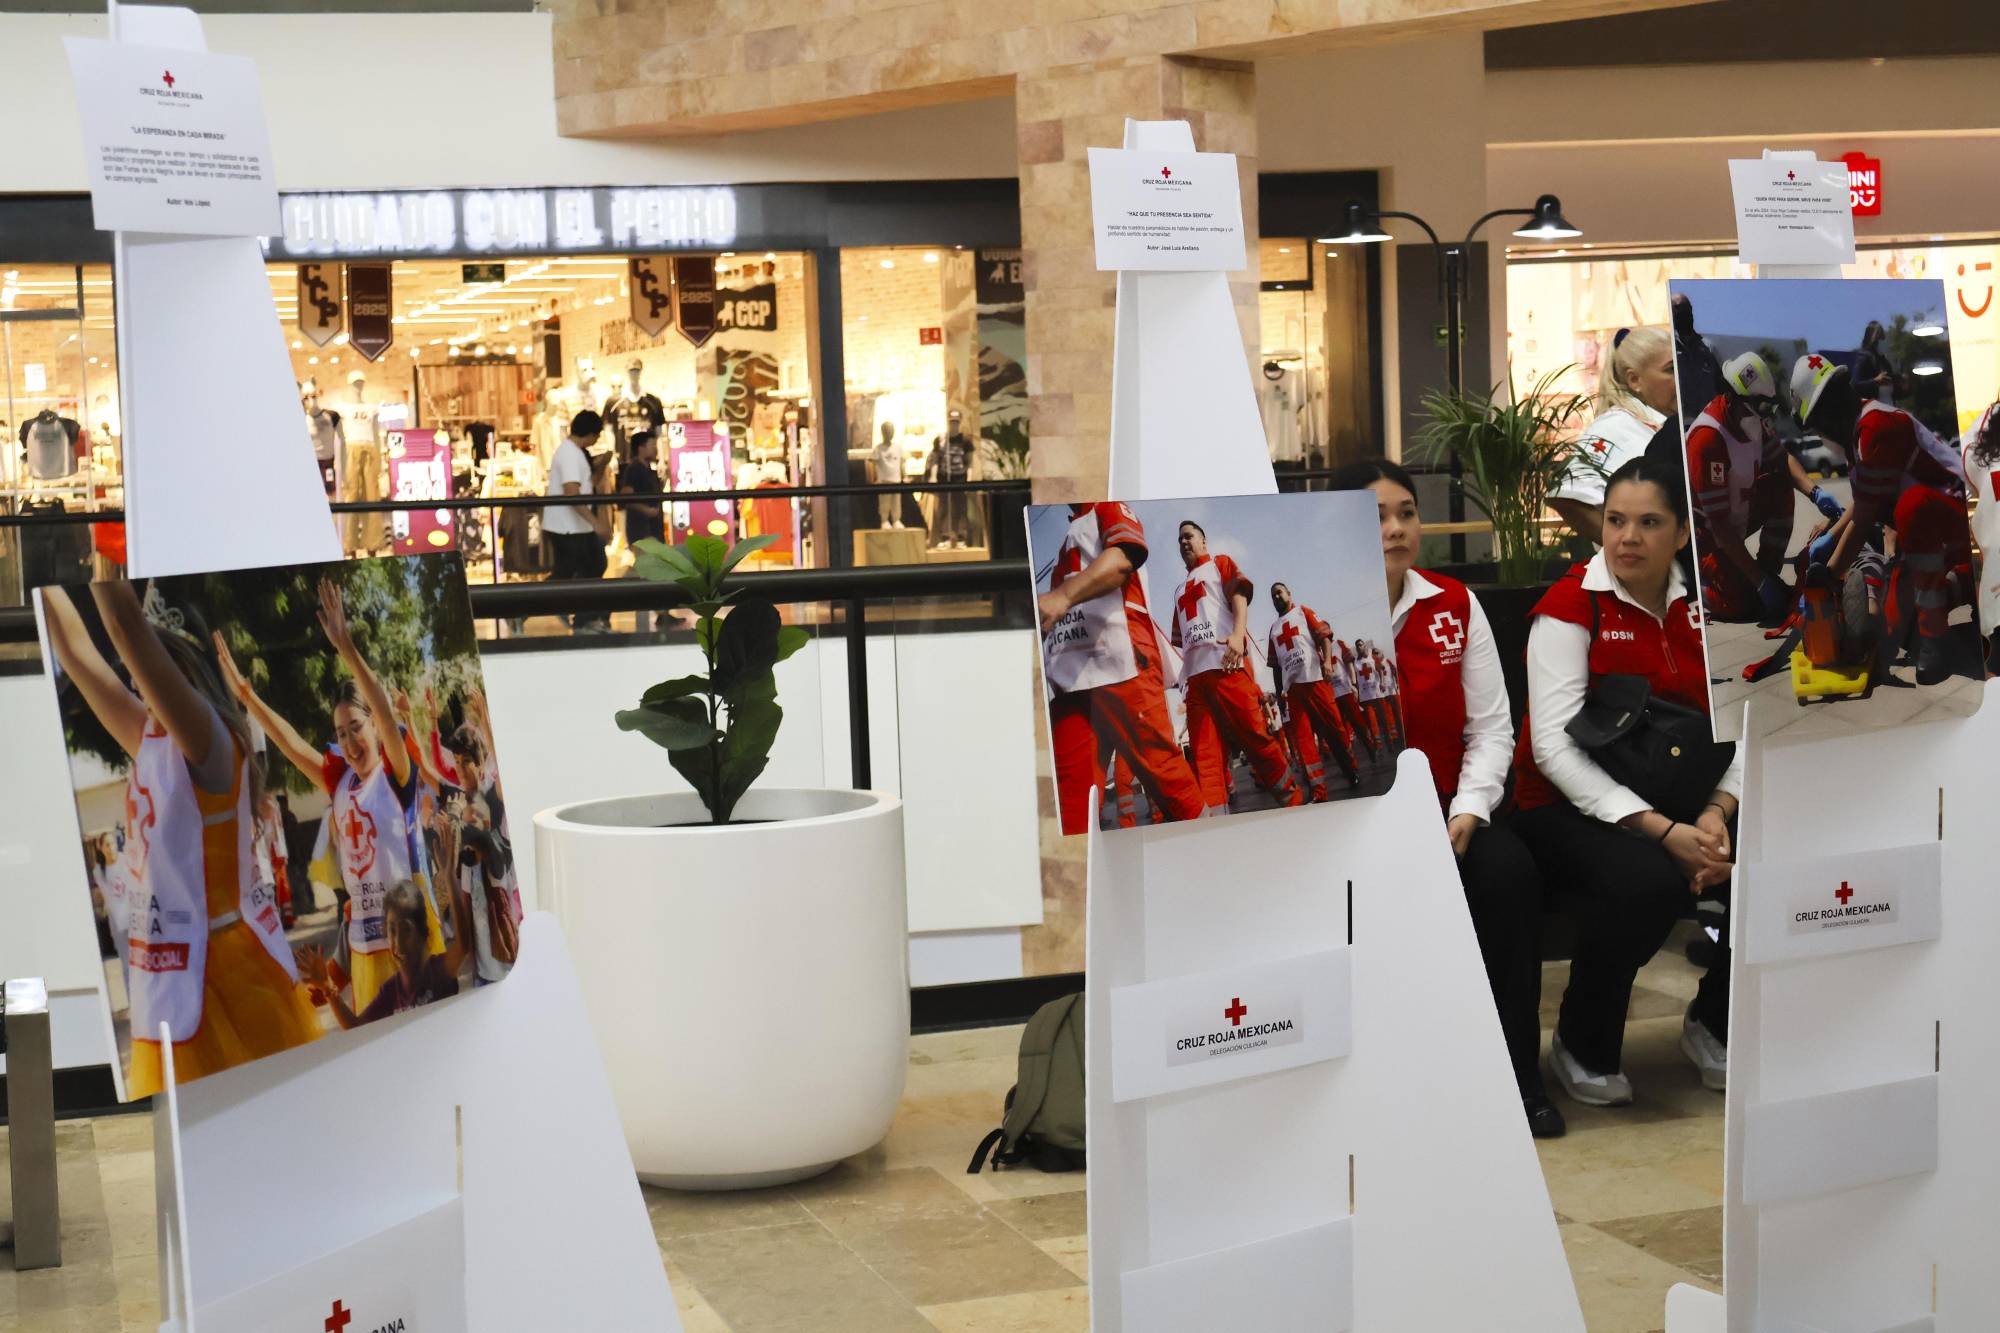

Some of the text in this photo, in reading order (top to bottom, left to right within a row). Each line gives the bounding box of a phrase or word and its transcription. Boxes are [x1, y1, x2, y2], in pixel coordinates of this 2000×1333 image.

[555, 188, 604, 248] EL
[611, 186, 736, 248] PERRO
[680, 292, 713, 304] 2025
[353, 303, 388, 316] 2025
[735, 300, 771, 326] CCP
[1610, 630, 1634, 641] DSN
[1796, 903, 1890, 922] CRUZ ROJA MEXICANA
[1176, 1020, 1293, 1050] CRUZ ROJA MEXICANA
